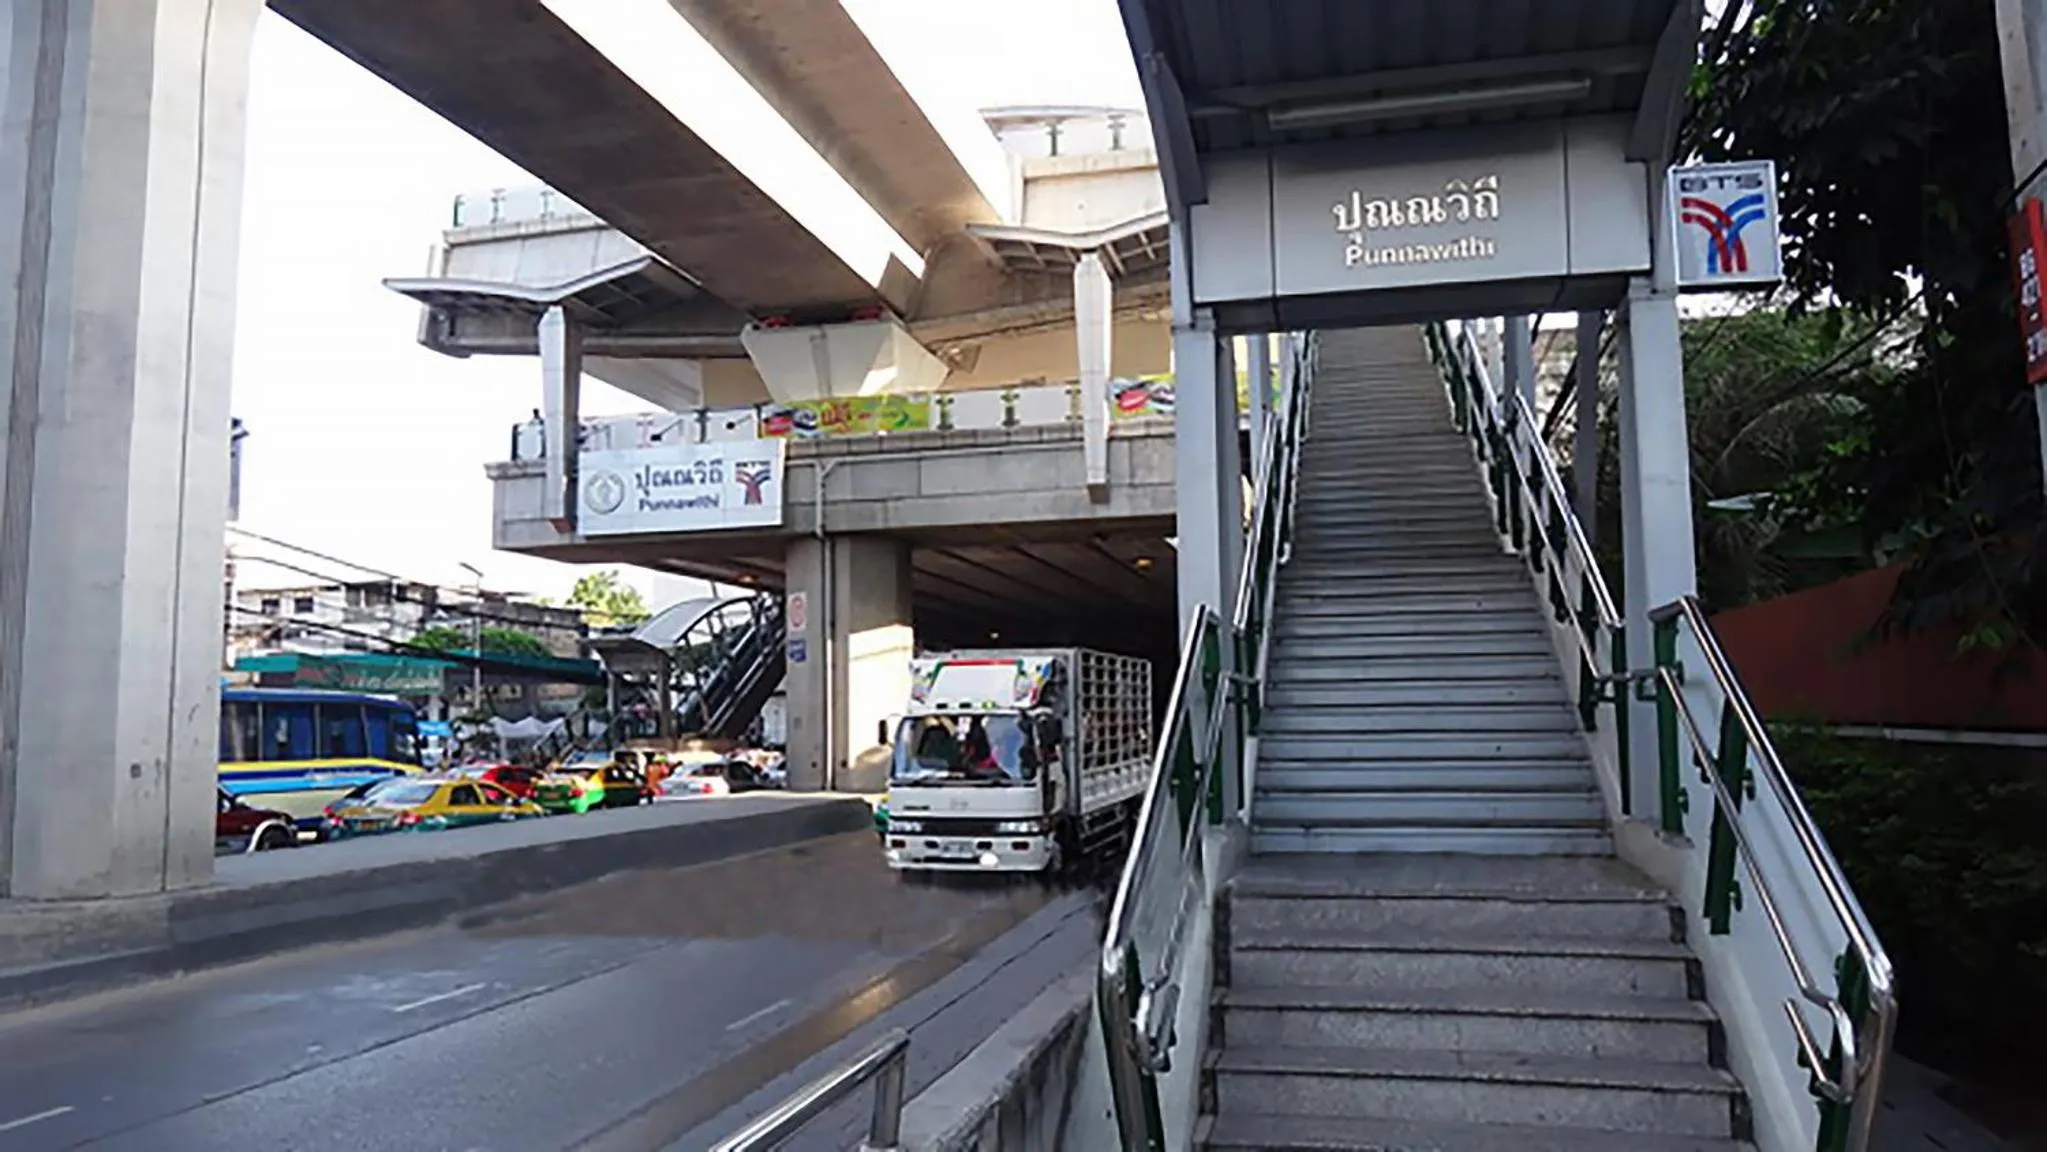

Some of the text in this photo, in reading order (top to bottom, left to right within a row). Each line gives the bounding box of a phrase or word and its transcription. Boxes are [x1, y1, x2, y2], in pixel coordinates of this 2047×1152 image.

[1680, 173, 1763, 192] BTS
[1332, 175, 1499, 245] ปุณณวิถี
[1345, 236, 1495, 266] Punnawithi
[635, 458, 723, 497] ปุณณวิถี
